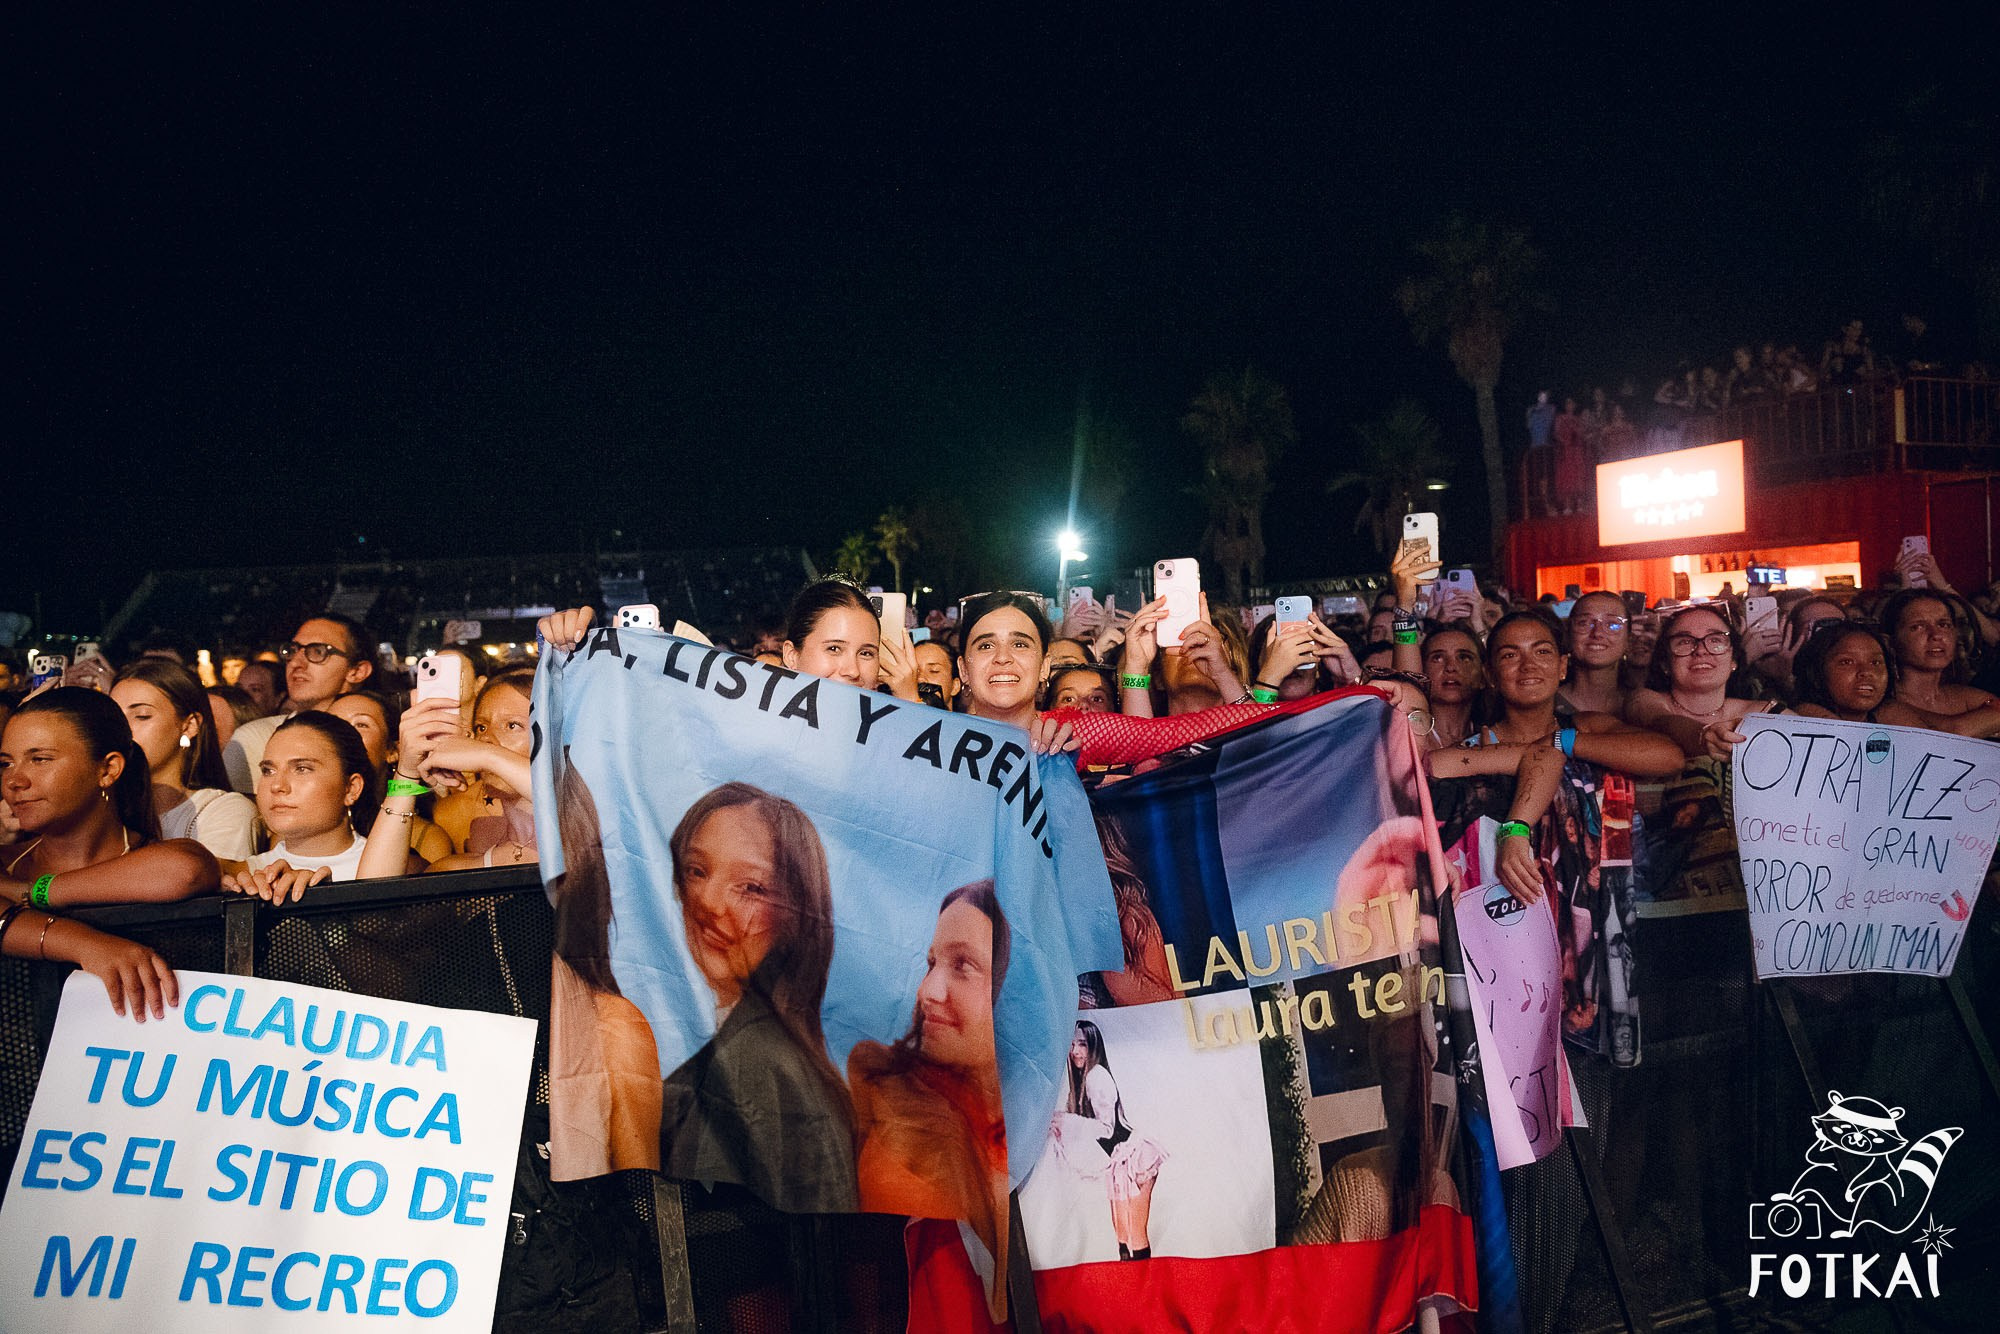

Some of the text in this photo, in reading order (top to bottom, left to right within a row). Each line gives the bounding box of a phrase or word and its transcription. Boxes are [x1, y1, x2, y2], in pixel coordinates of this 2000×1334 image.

[663, 640, 821, 730] LISTA
[853, 693, 900, 746] Y
[903, 718, 1053, 858] ARENI
[1741, 729, 1976, 821] OTRA VEZ
[1827, 822, 1850, 852] el
[1863, 827, 1950, 873] GRAN
[1835, 877, 1856, 910] de
[1773, 918, 1847, 973] COMO
[1848, 922, 1883, 971] UN
[183, 984, 447, 1072] CLAUDIA
[1182, 988, 1335, 1050] laura
[1347, 971, 1407, 1019] te
[86, 1046, 462, 1145] TU MÚSICA
[207, 1144, 389, 1217] SITIO
[407, 1167, 494, 1227] DE
[33, 1235, 459, 1318] MI RECREO
